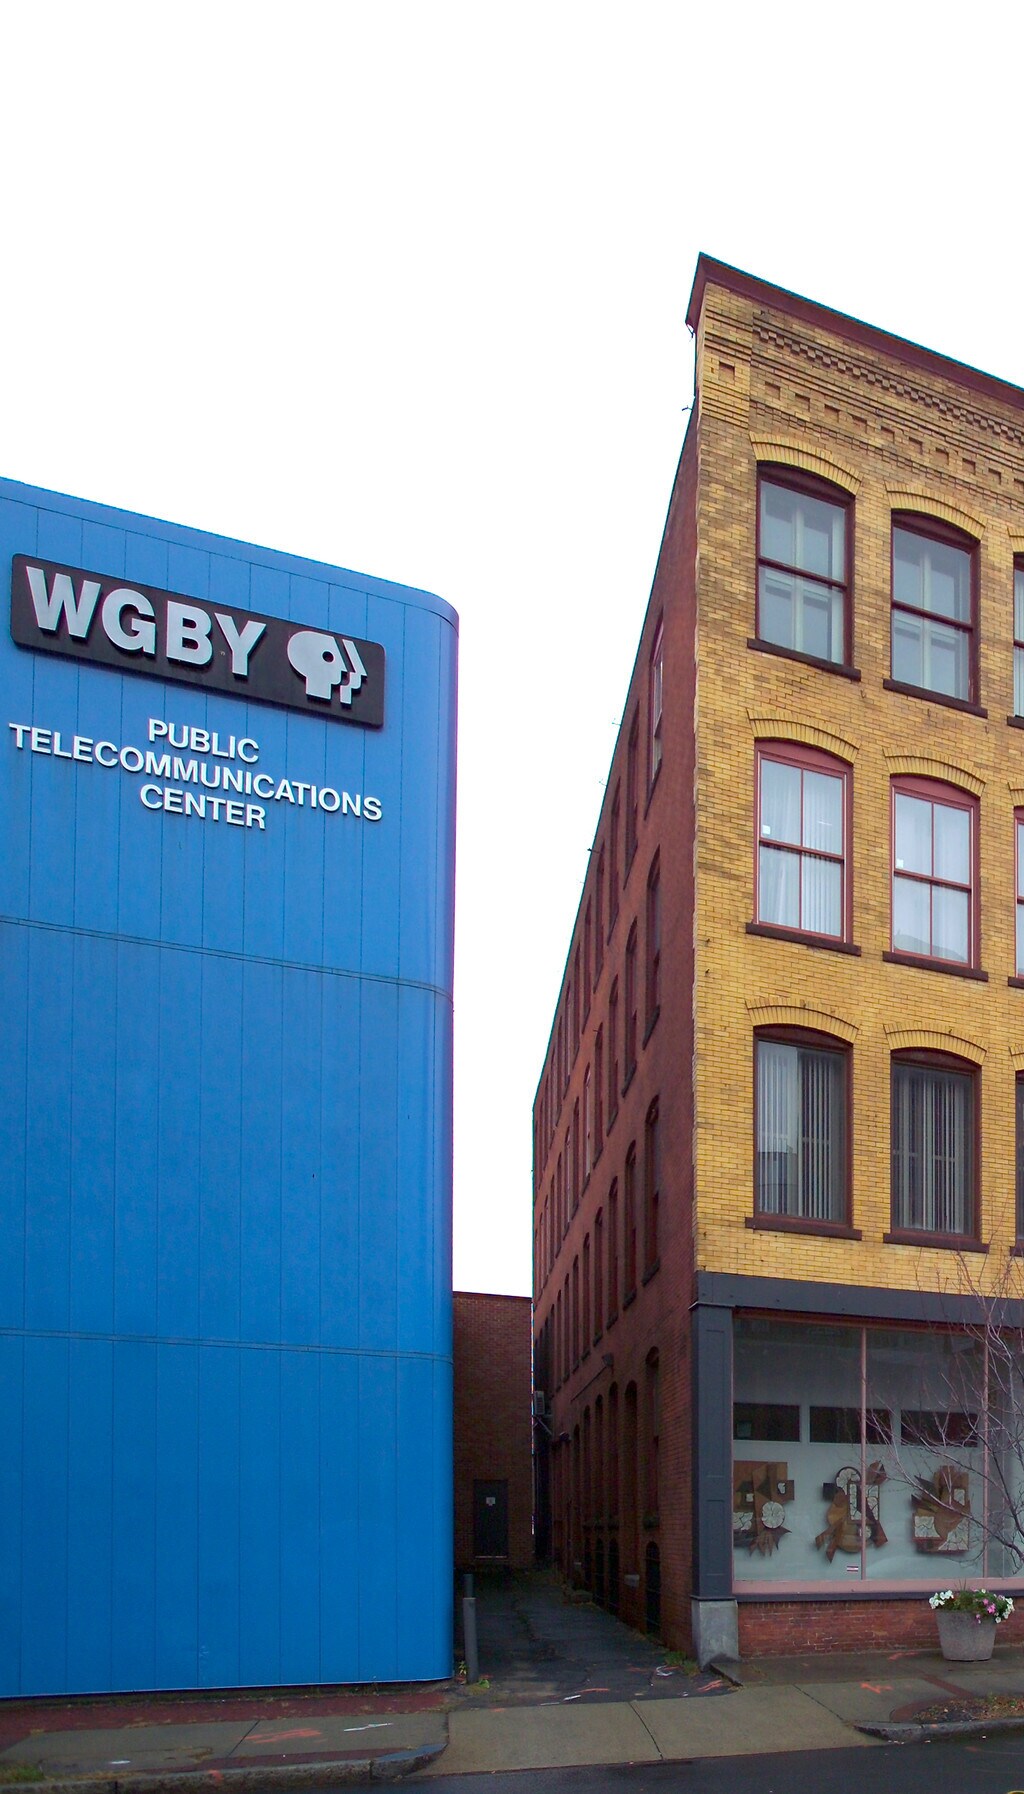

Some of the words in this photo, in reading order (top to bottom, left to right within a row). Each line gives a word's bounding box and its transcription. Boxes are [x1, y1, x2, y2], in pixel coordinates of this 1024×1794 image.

[25, 566, 267, 677] WGBY
[8, 723, 383, 822] TELECOMMUNICATIONS
[148, 718, 260, 764] PUBLIC
[140, 783, 266, 830] CENTER
